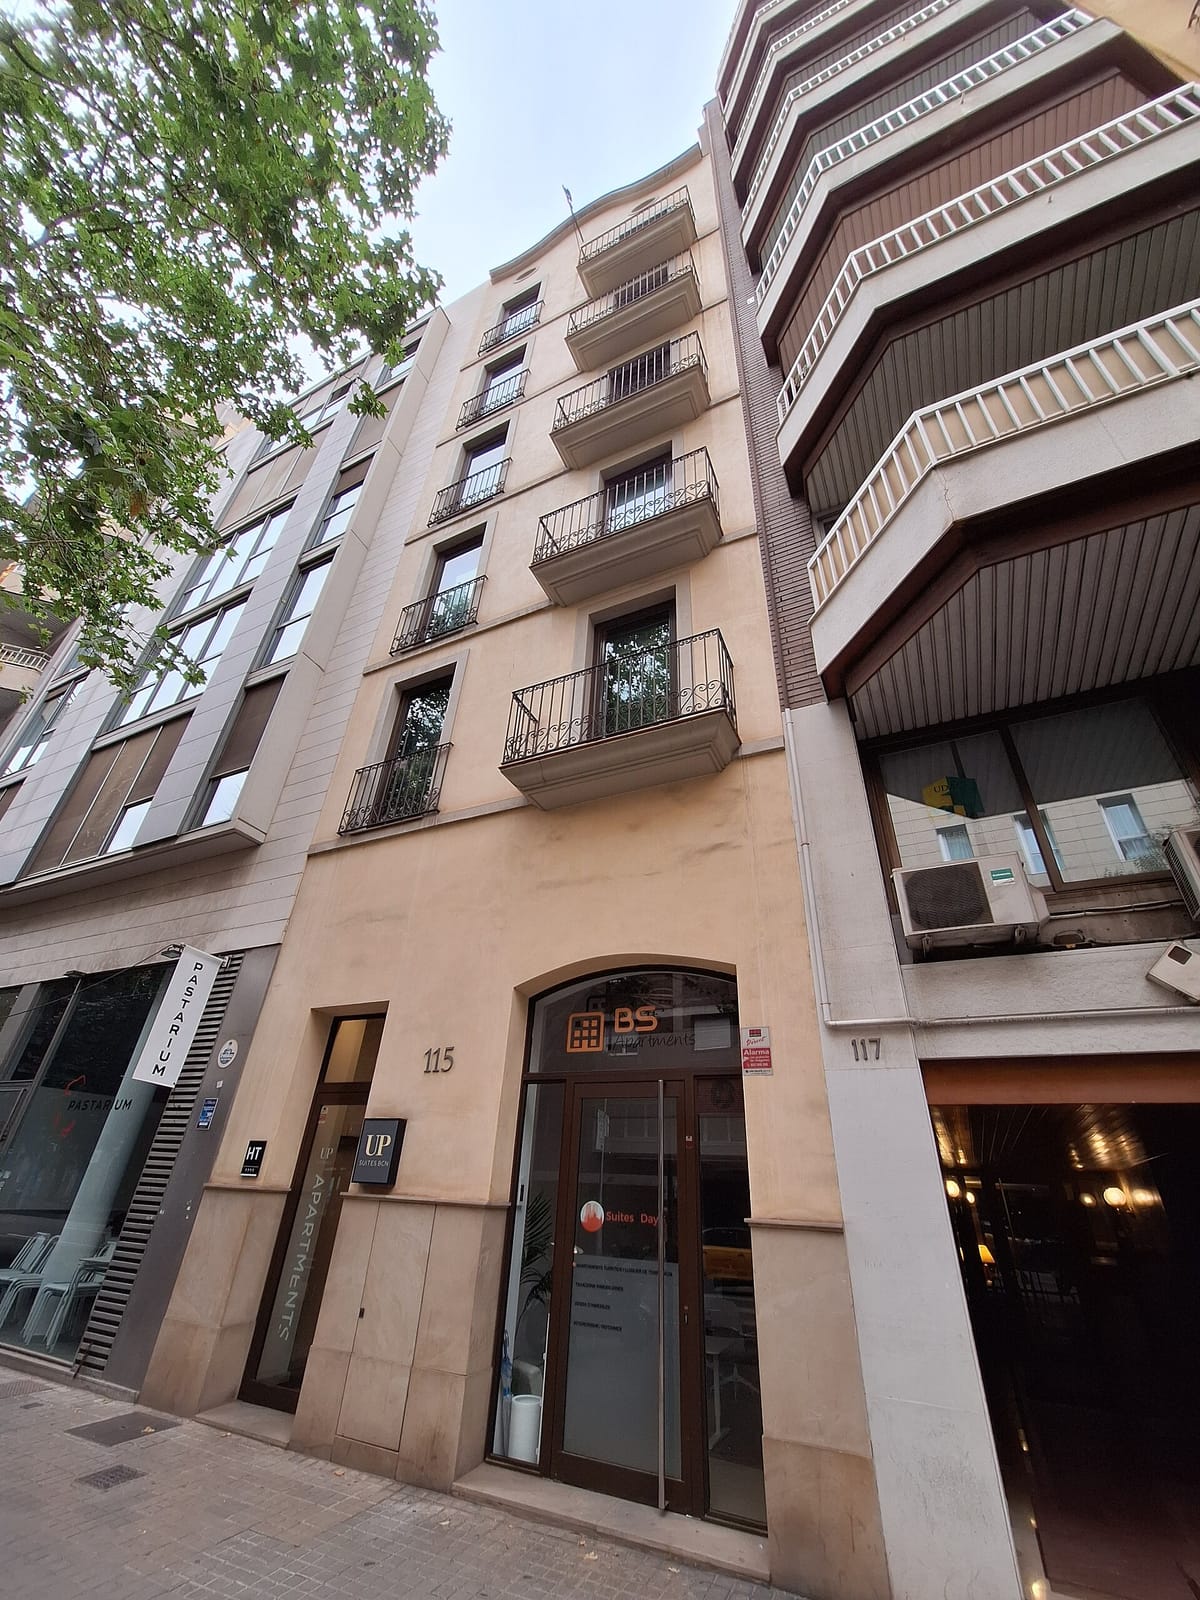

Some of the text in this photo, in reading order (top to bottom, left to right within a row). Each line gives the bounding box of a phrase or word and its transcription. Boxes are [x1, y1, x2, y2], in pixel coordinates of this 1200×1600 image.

[152, 962, 203, 1077] PASTARIUM
[614, 1005, 658, 1033] BS
[612, 1032, 696, 1055] Apartments
[743, 1049, 770, 1057] Alarma
[851, 1038, 881, 1061] 117
[423, 1046, 455, 1073] 115
[66, 1099, 134, 1112] PASTARUM
[246, 1146, 263, 1160] HT
[320, 1147, 334, 1160] UP
[365, 1134, 392, 1156] UP
[359, 1159, 377, 1167] SUITES
[605, 1211, 635, 1223] Suites
[278, 1173, 325, 1342] APARTMENTS
